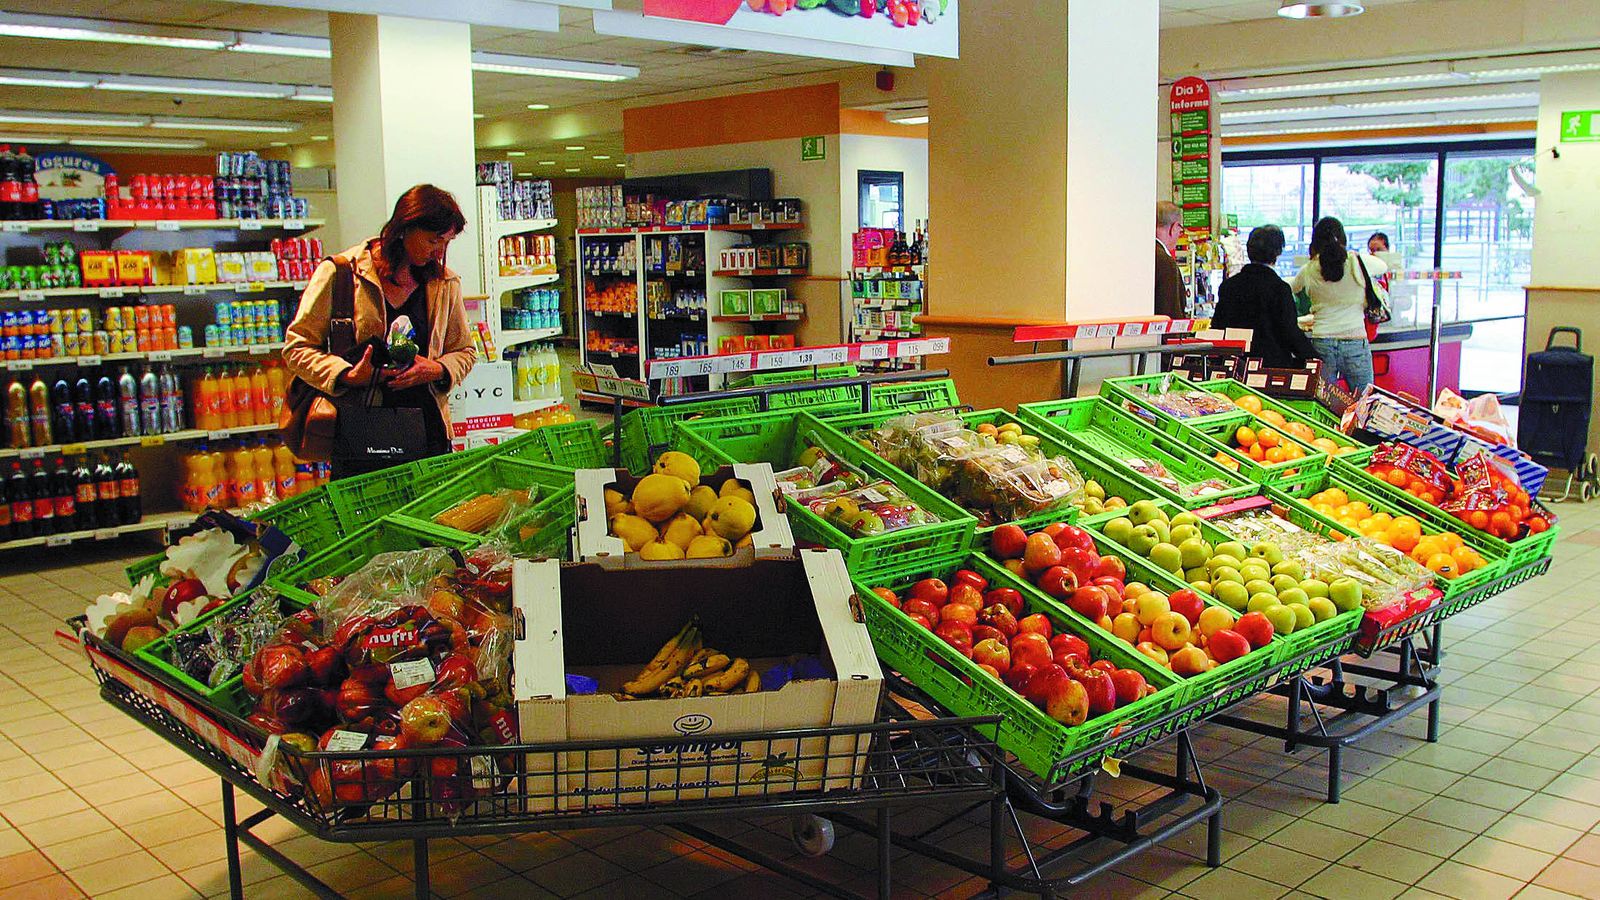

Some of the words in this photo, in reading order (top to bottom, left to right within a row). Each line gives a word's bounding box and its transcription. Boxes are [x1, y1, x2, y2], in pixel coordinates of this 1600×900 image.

[1175, 85, 1194, 96] Dia
[1171, 99, 1209, 109] Informa
[770, 356, 783, 367] 159
[799, 354, 813, 364] 1,39
[368, 629, 418, 646] nufri
